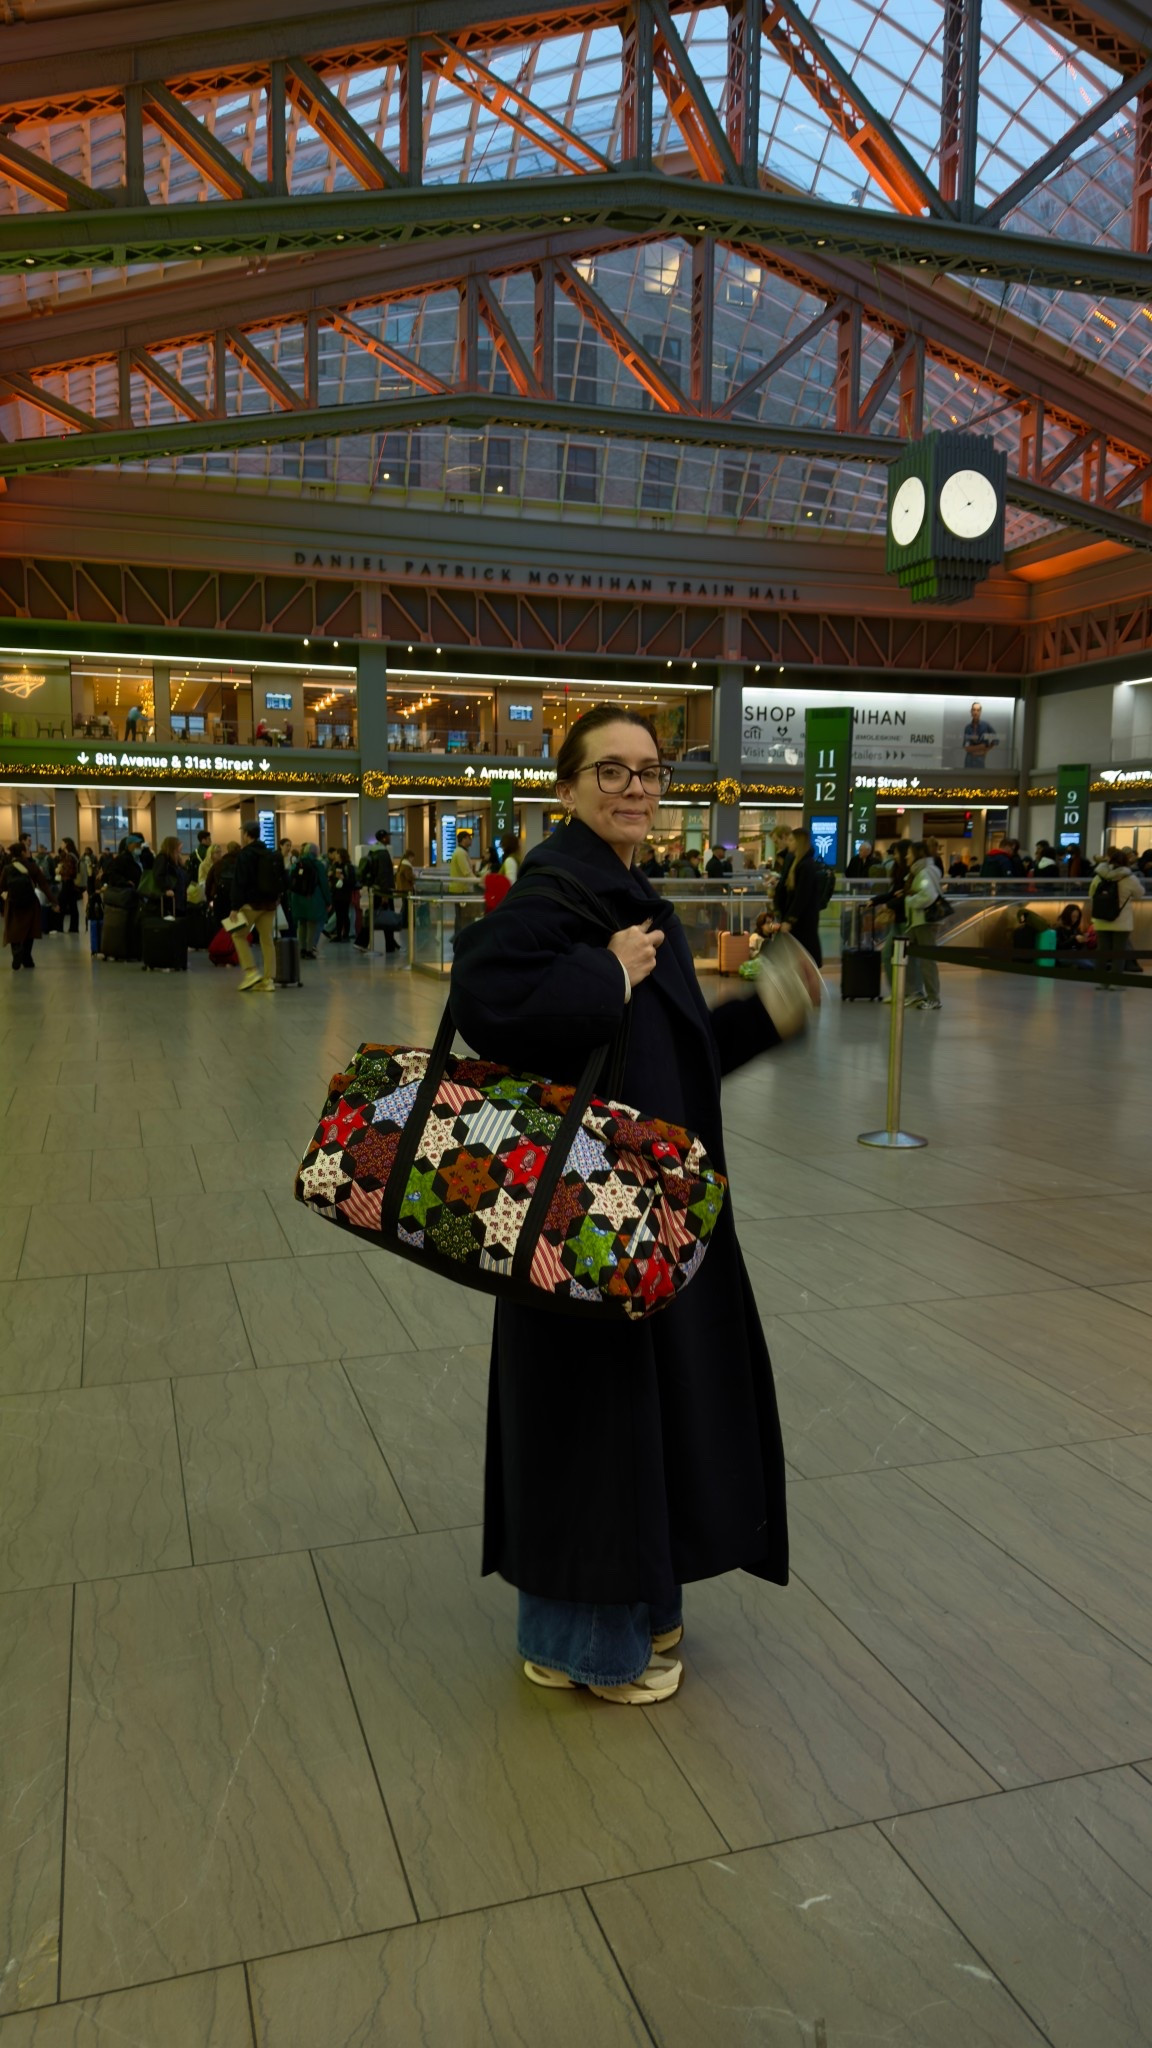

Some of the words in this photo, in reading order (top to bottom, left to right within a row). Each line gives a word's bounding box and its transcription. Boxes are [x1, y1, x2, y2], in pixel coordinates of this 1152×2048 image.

[295, 552, 386, 572] DANIEL
[405, 561, 511, 582] PATRICK
[529, 571, 651, 591] MOYNIHAN
[667, 580, 734, 597] TRAIN
[749, 586, 800, 601] HALL
[744, 705, 796, 722] SHOP
[743, 726, 762, 740] citi
[910, 734, 935, 744] RAINS
[743, 747, 765, 757] Visit
[851, 749, 883, 760] tailers
[95, 752, 117, 766] 8th
[120, 753, 168, 768] Avenue
[171, 755, 181, 768] &
[184, 756, 212, 770] 31st
[214, 757, 254, 771] Street
[818, 749, 836, 769] 11
[480, 766, 522, 780] Amtrak
[523, 767, 557, 780] Metro
[1117, 771, 1152, 781] AMTR
[855, 776, 877, 788] 31st
[877, 776, 908, 788] Street
[815, 781, 836, 802] 12
[1067, 790, 1078, 804] 9
[498, 800, 505, 812] 7
[860, 806, 868, 818] 7
[497, 818, 505, 830] 8
[1063, 811, 1080, 825] 10
[859, 822, 867, 834] 8
